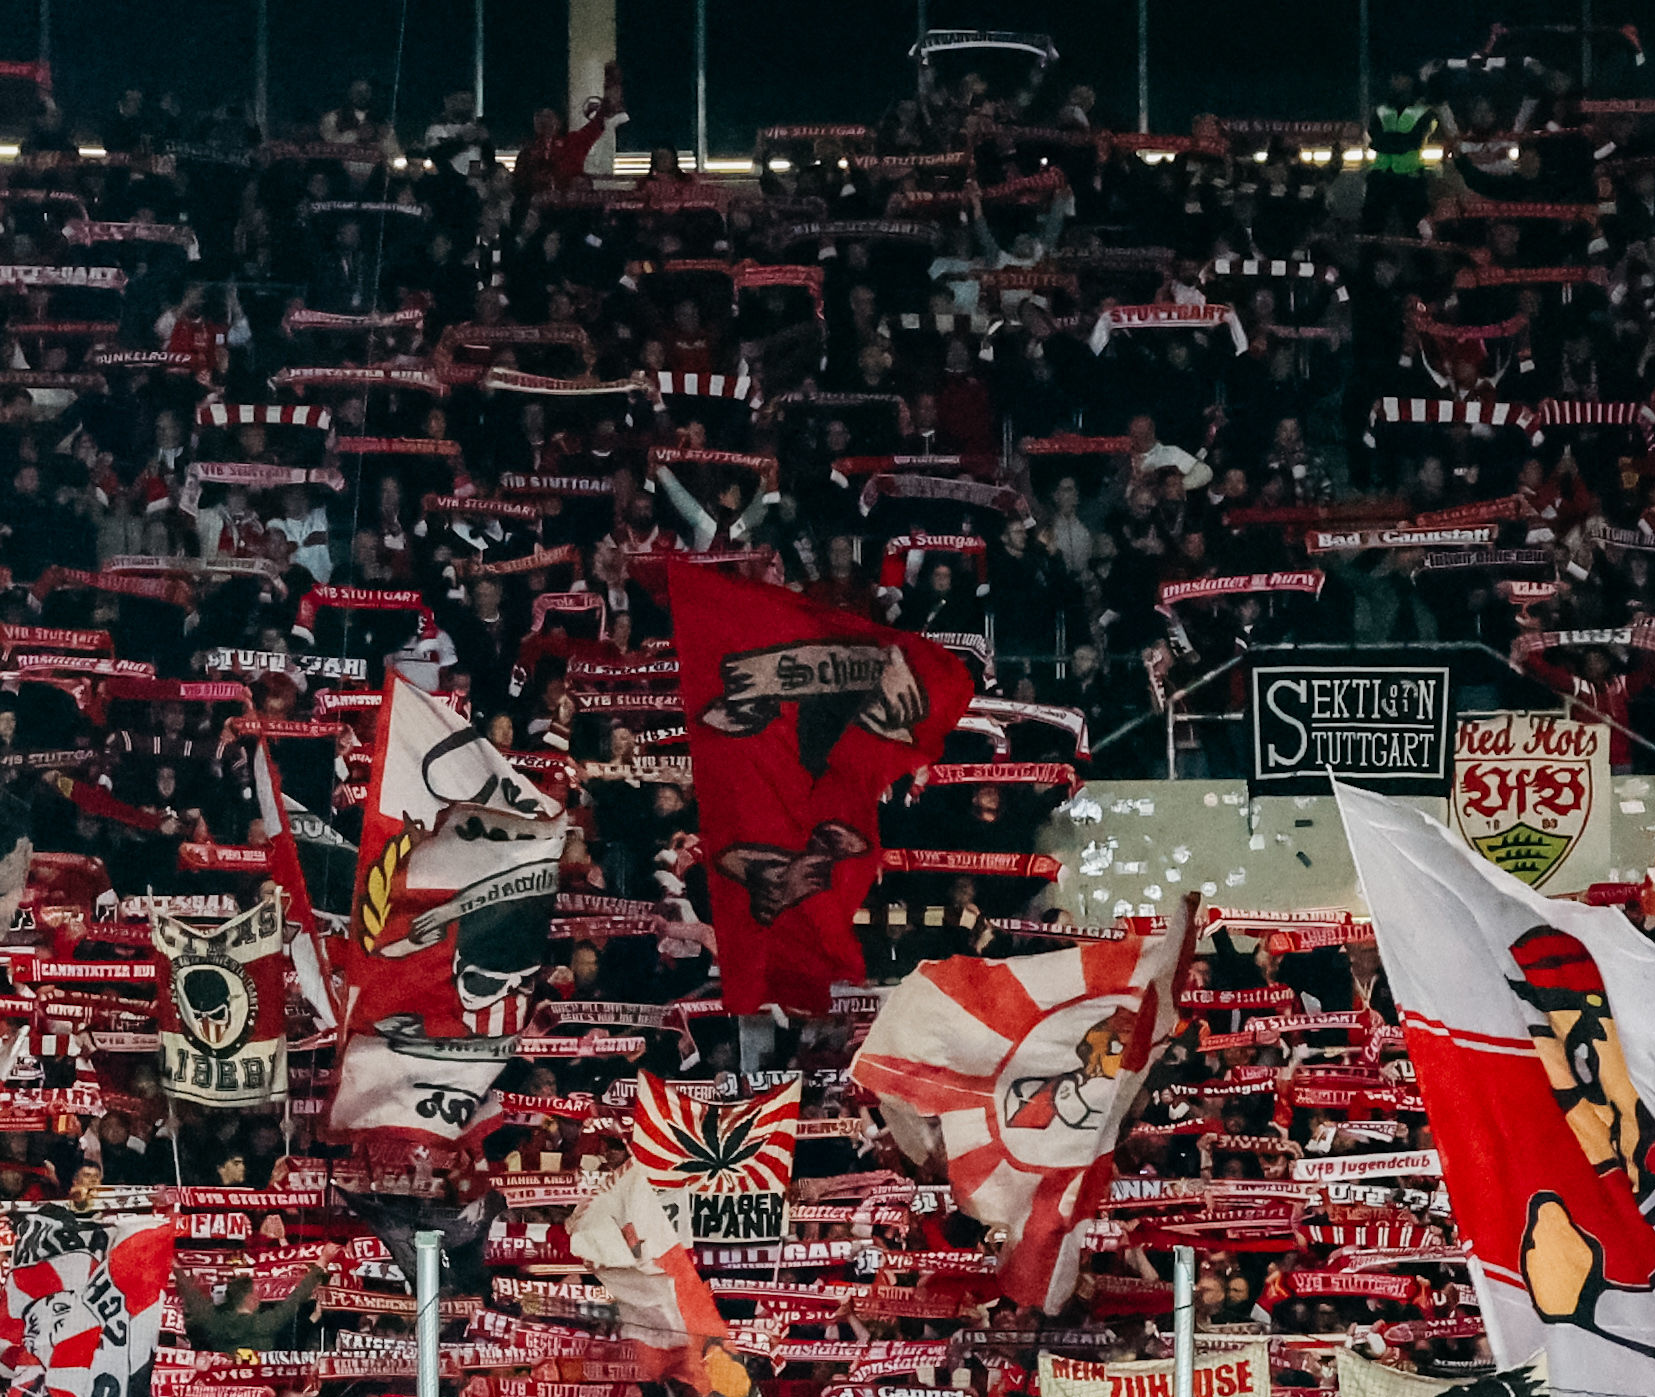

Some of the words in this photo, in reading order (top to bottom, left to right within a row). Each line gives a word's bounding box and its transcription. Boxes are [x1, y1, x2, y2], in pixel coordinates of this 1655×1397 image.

[1110, 306, 1228, 323] STUTTGART
[1457, 723, 1513, 755] Red
[1525, 718, 1600, 757] Hots
[1462, 762, 1583, 817] VfB
[1303, 1160, 1336, 1179] VfB
[1340, 1154, 1435, 1179] Jugendclub
[196, 1192, 224, 1204] VfB
[228, 1192, 317, 1206] STUTTGART
[1052, 1359, 1105, 1381] MEIN
